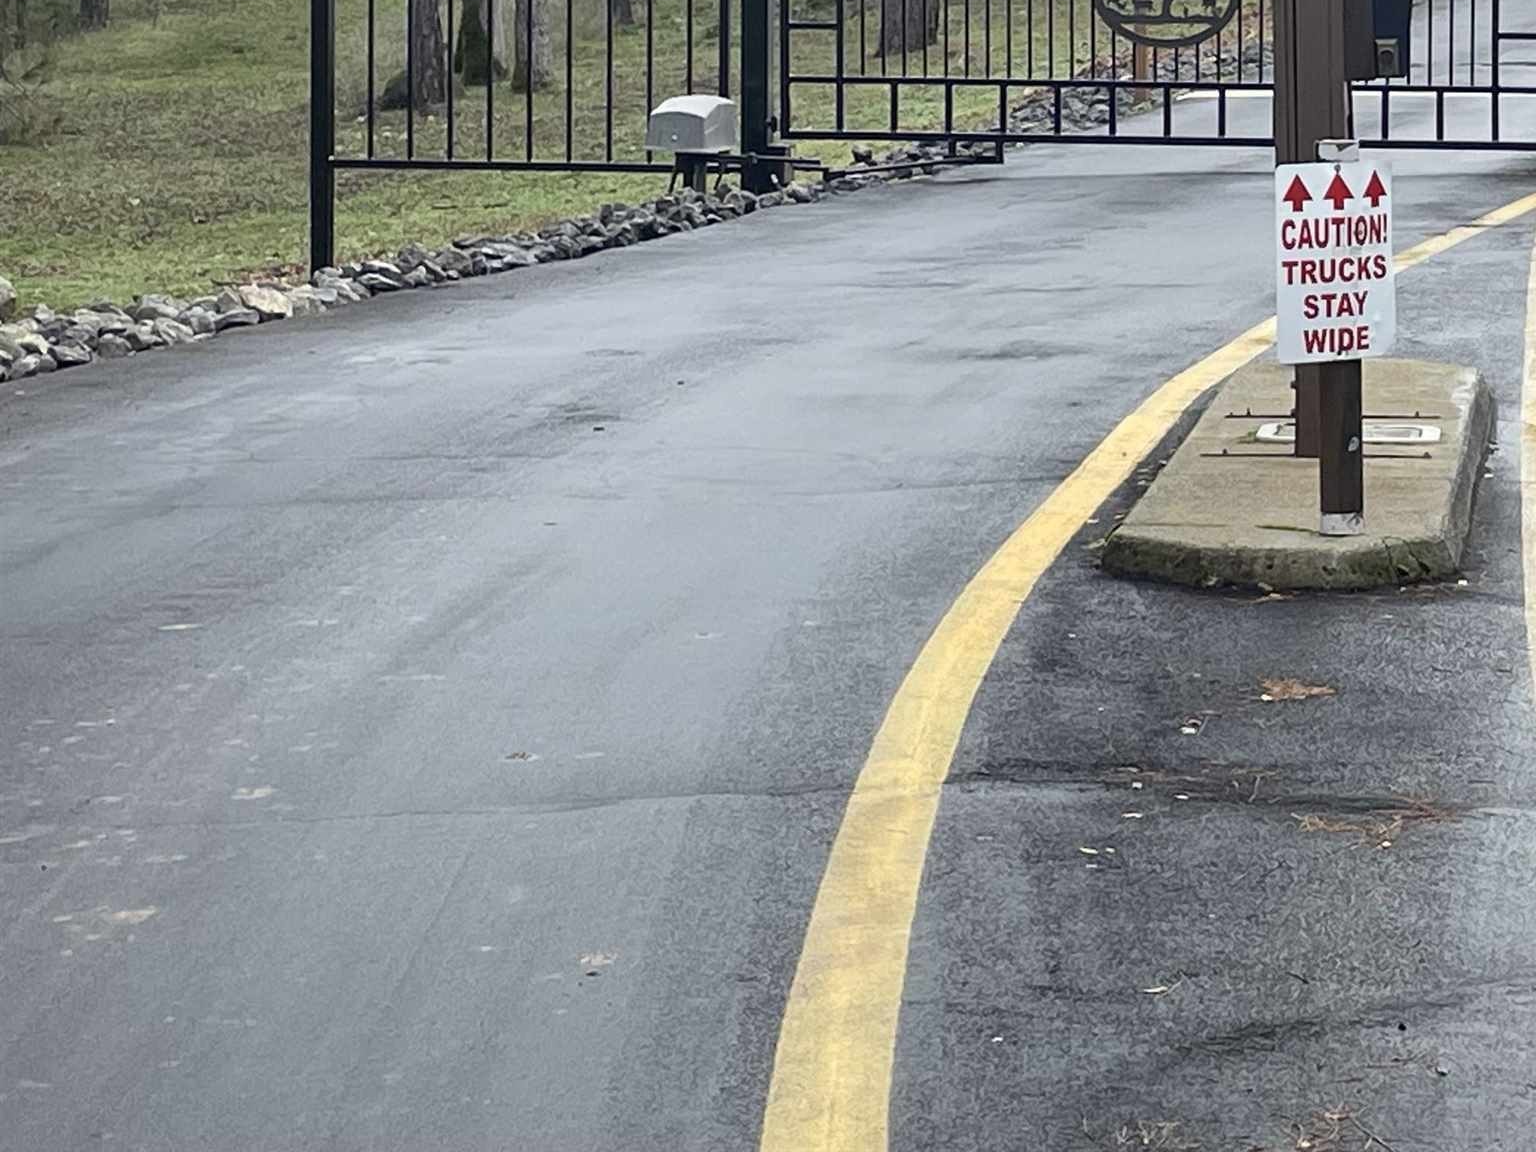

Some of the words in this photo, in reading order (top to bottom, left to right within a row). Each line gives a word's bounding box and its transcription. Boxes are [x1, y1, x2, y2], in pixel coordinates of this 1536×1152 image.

[1281, 213, 1388, 250] CAUTION!
[1281, 255, 1387, 285] TRUCKS
[1303, 291, 1369, 319] STAY
[1303, 325, 1370, 354] WIDE
